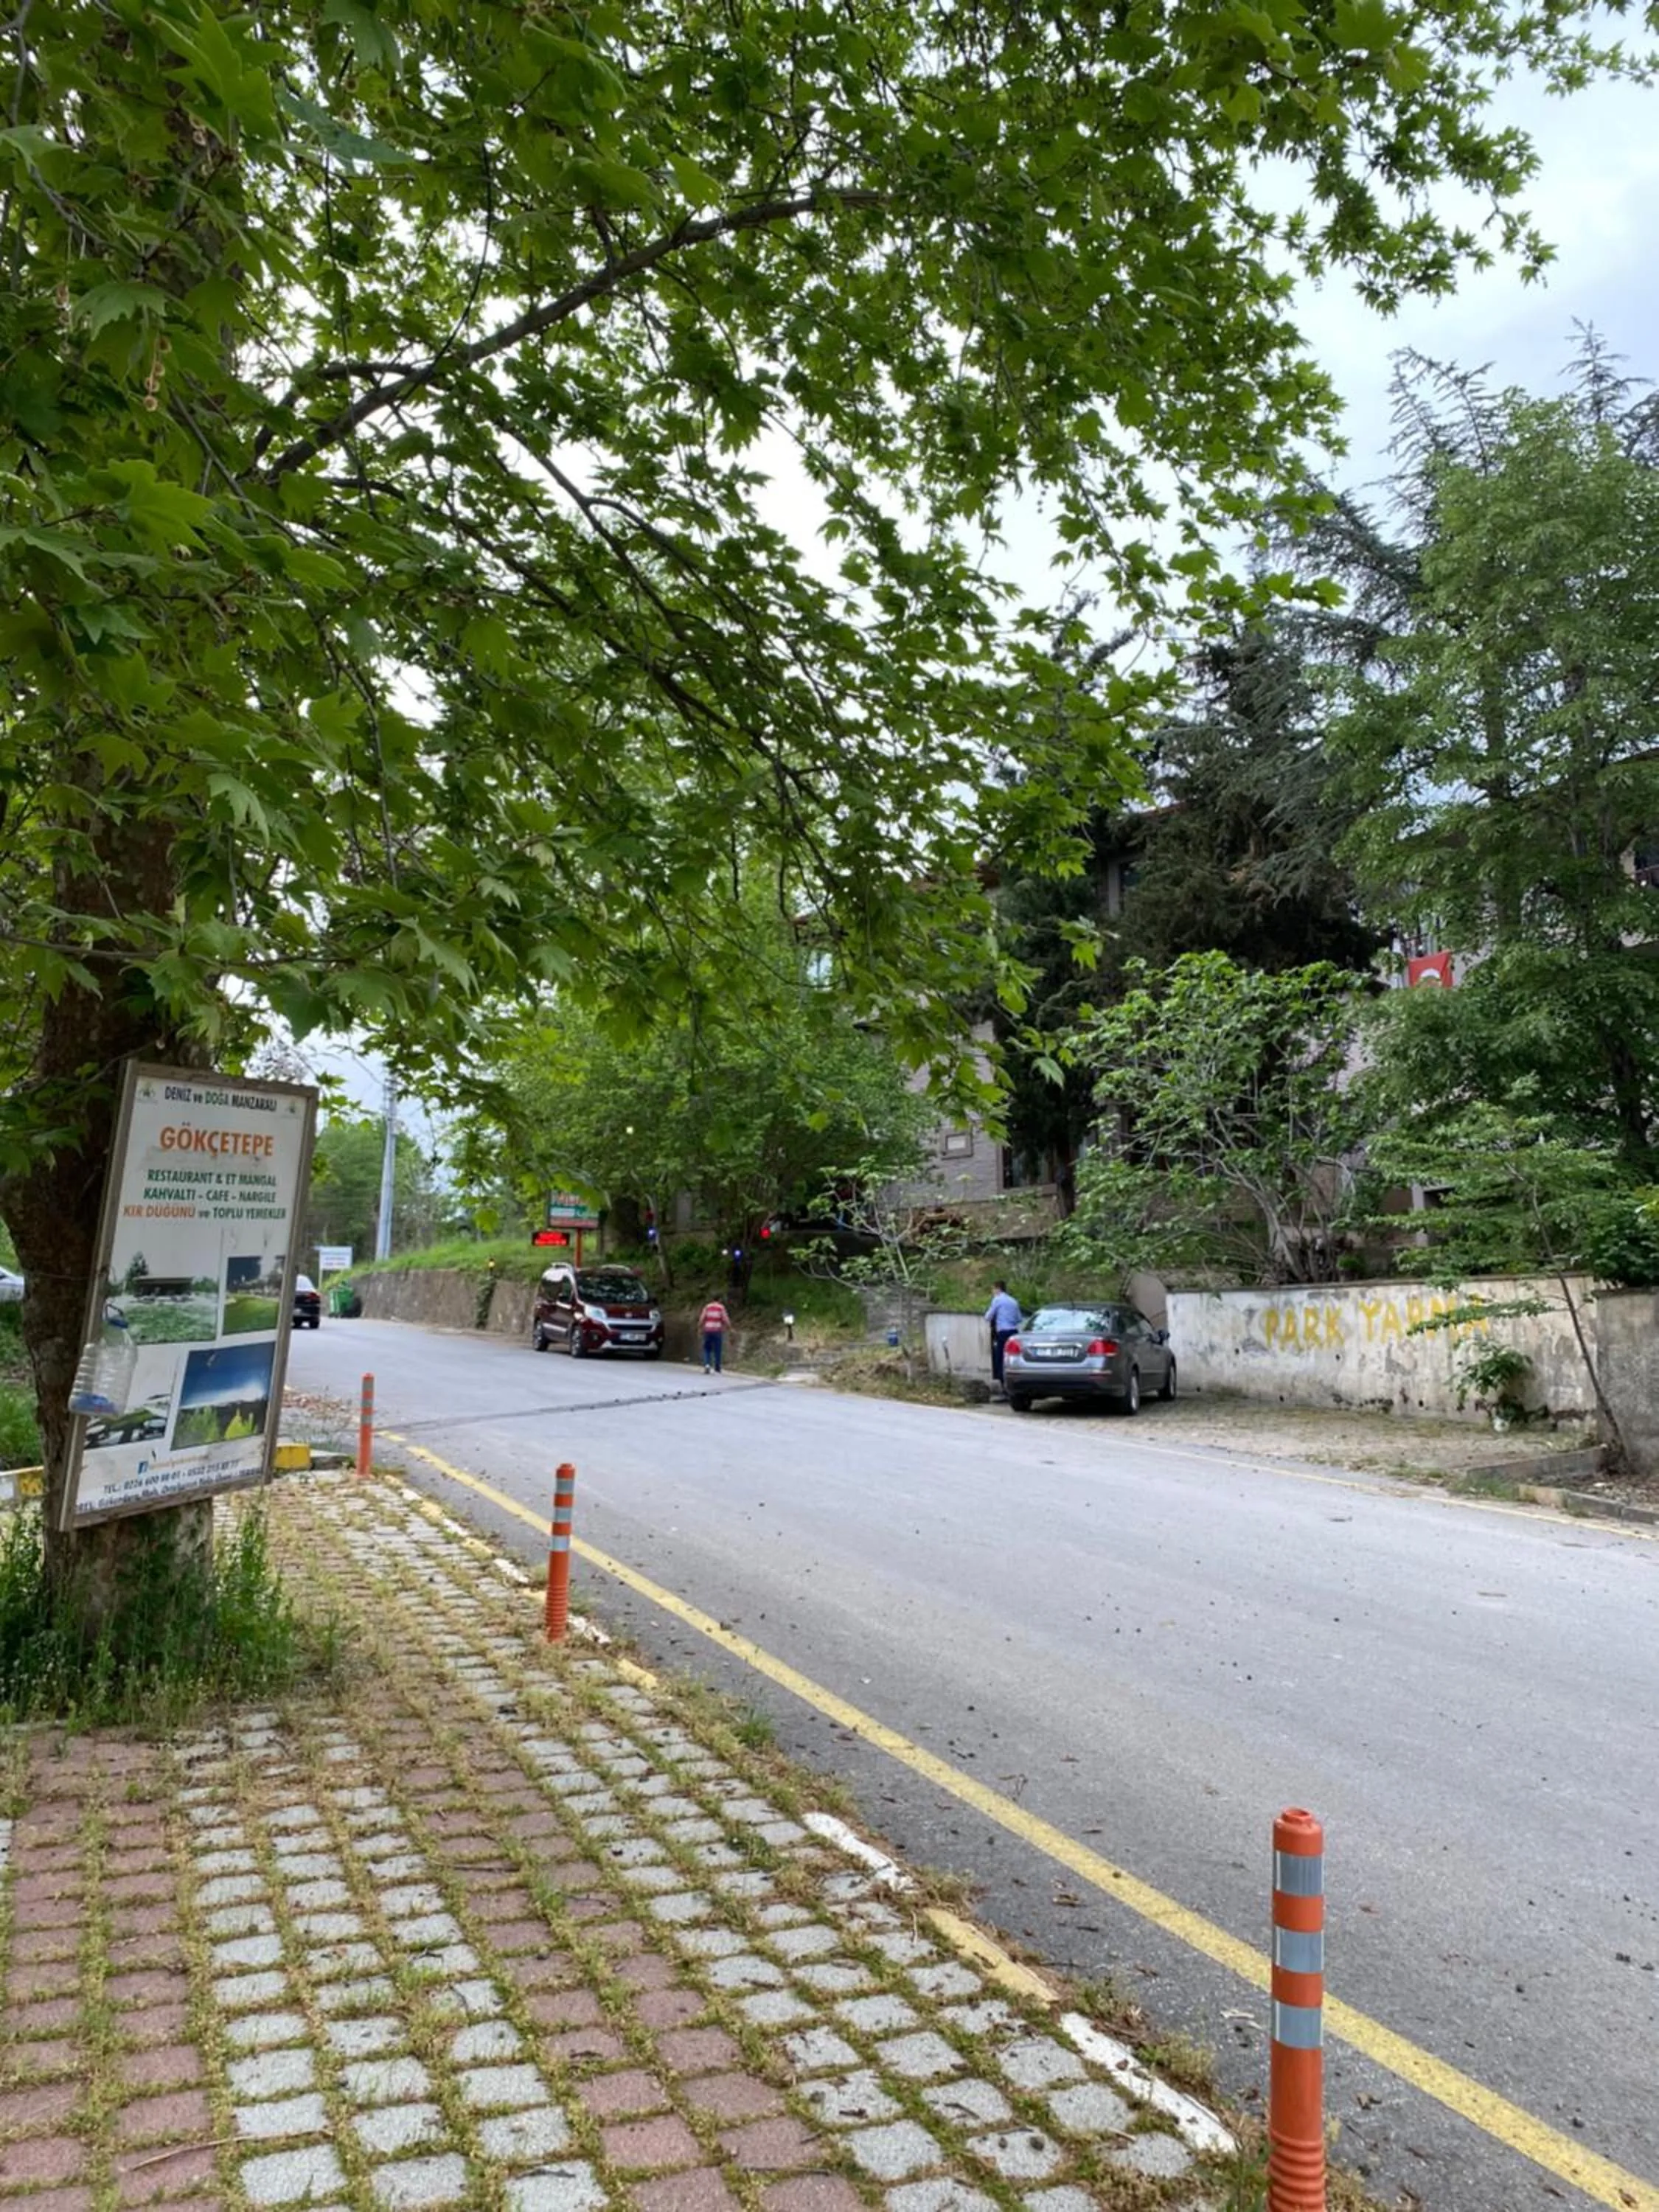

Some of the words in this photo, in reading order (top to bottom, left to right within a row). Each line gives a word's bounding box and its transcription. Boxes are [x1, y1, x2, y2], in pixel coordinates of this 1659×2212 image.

[160, 1121, 274, 1157] GÖKÇETEPE
[147, 1169, 213, 1184] RESTAURANT
[238, 1174, 276, 1187] MANGAL
[143, 1187, 196, 1201] KAHVALTI
[206, 1189, 229, 1203] CAFE
[213, 1206, 243, 1220] TOPLU
[1264, 1306, 1346, 1353] PARK
